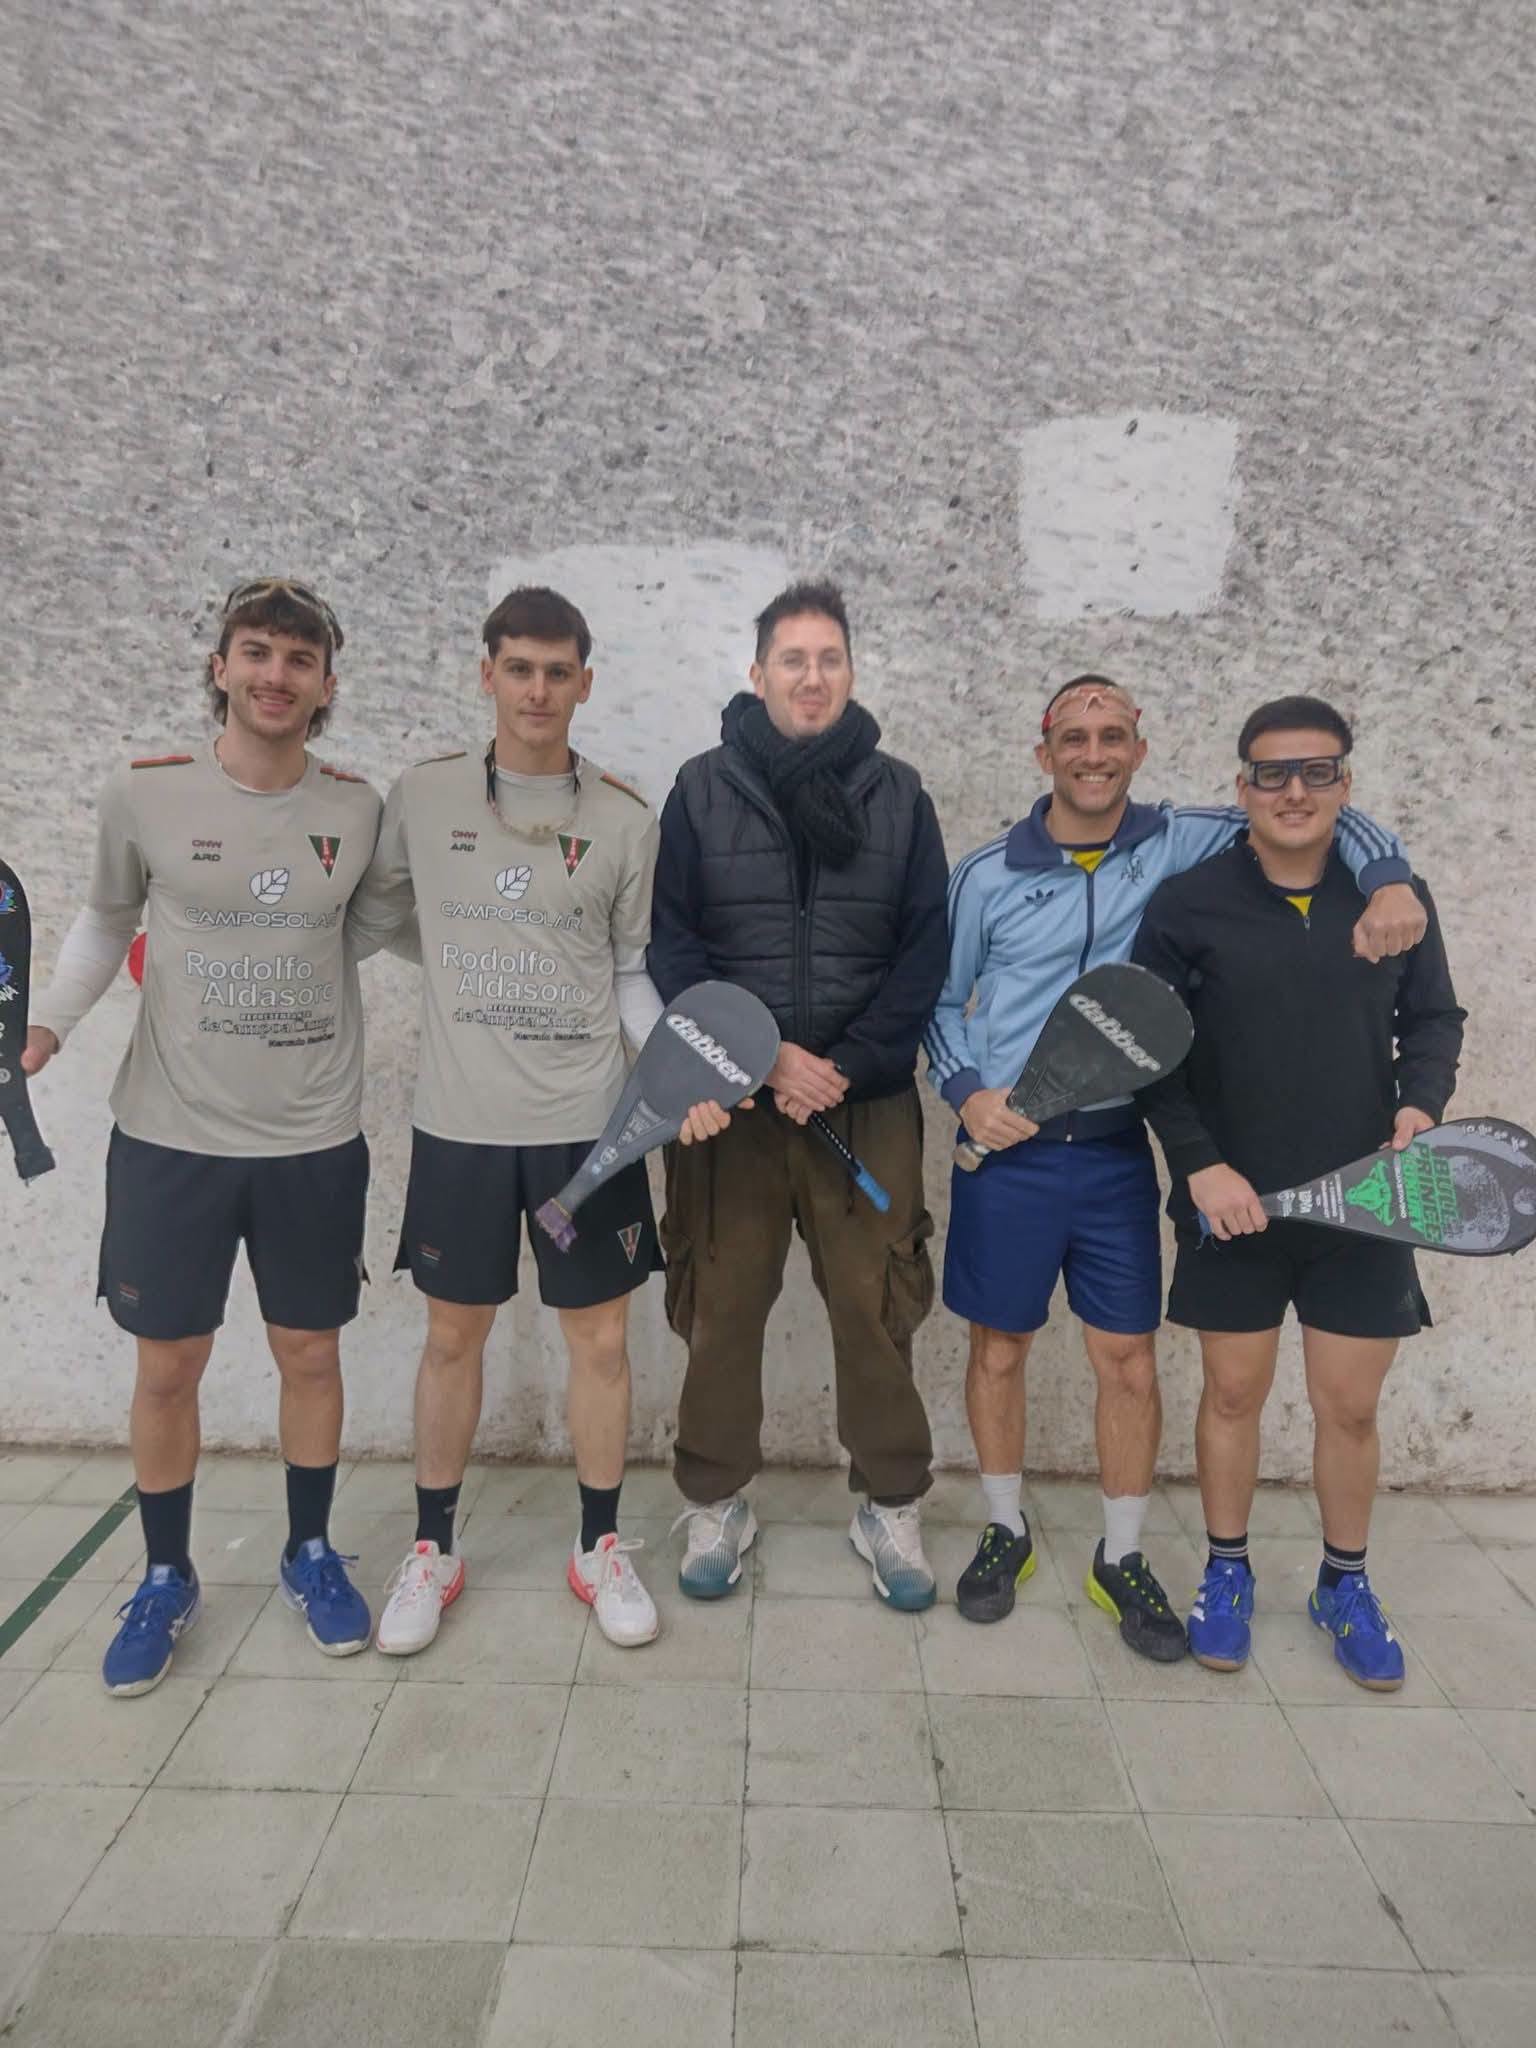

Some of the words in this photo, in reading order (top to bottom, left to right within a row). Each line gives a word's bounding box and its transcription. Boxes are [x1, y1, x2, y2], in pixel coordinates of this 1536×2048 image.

[441, 902, 583, 930] CAMPOSOLAR
[185, 949, 312, 981] Rodolfo
[441, 943, 557, 976] Rodolfo
[457, 973, 586, 1002] Aldasoro
[666, 1014, 752, 1086] dabber
